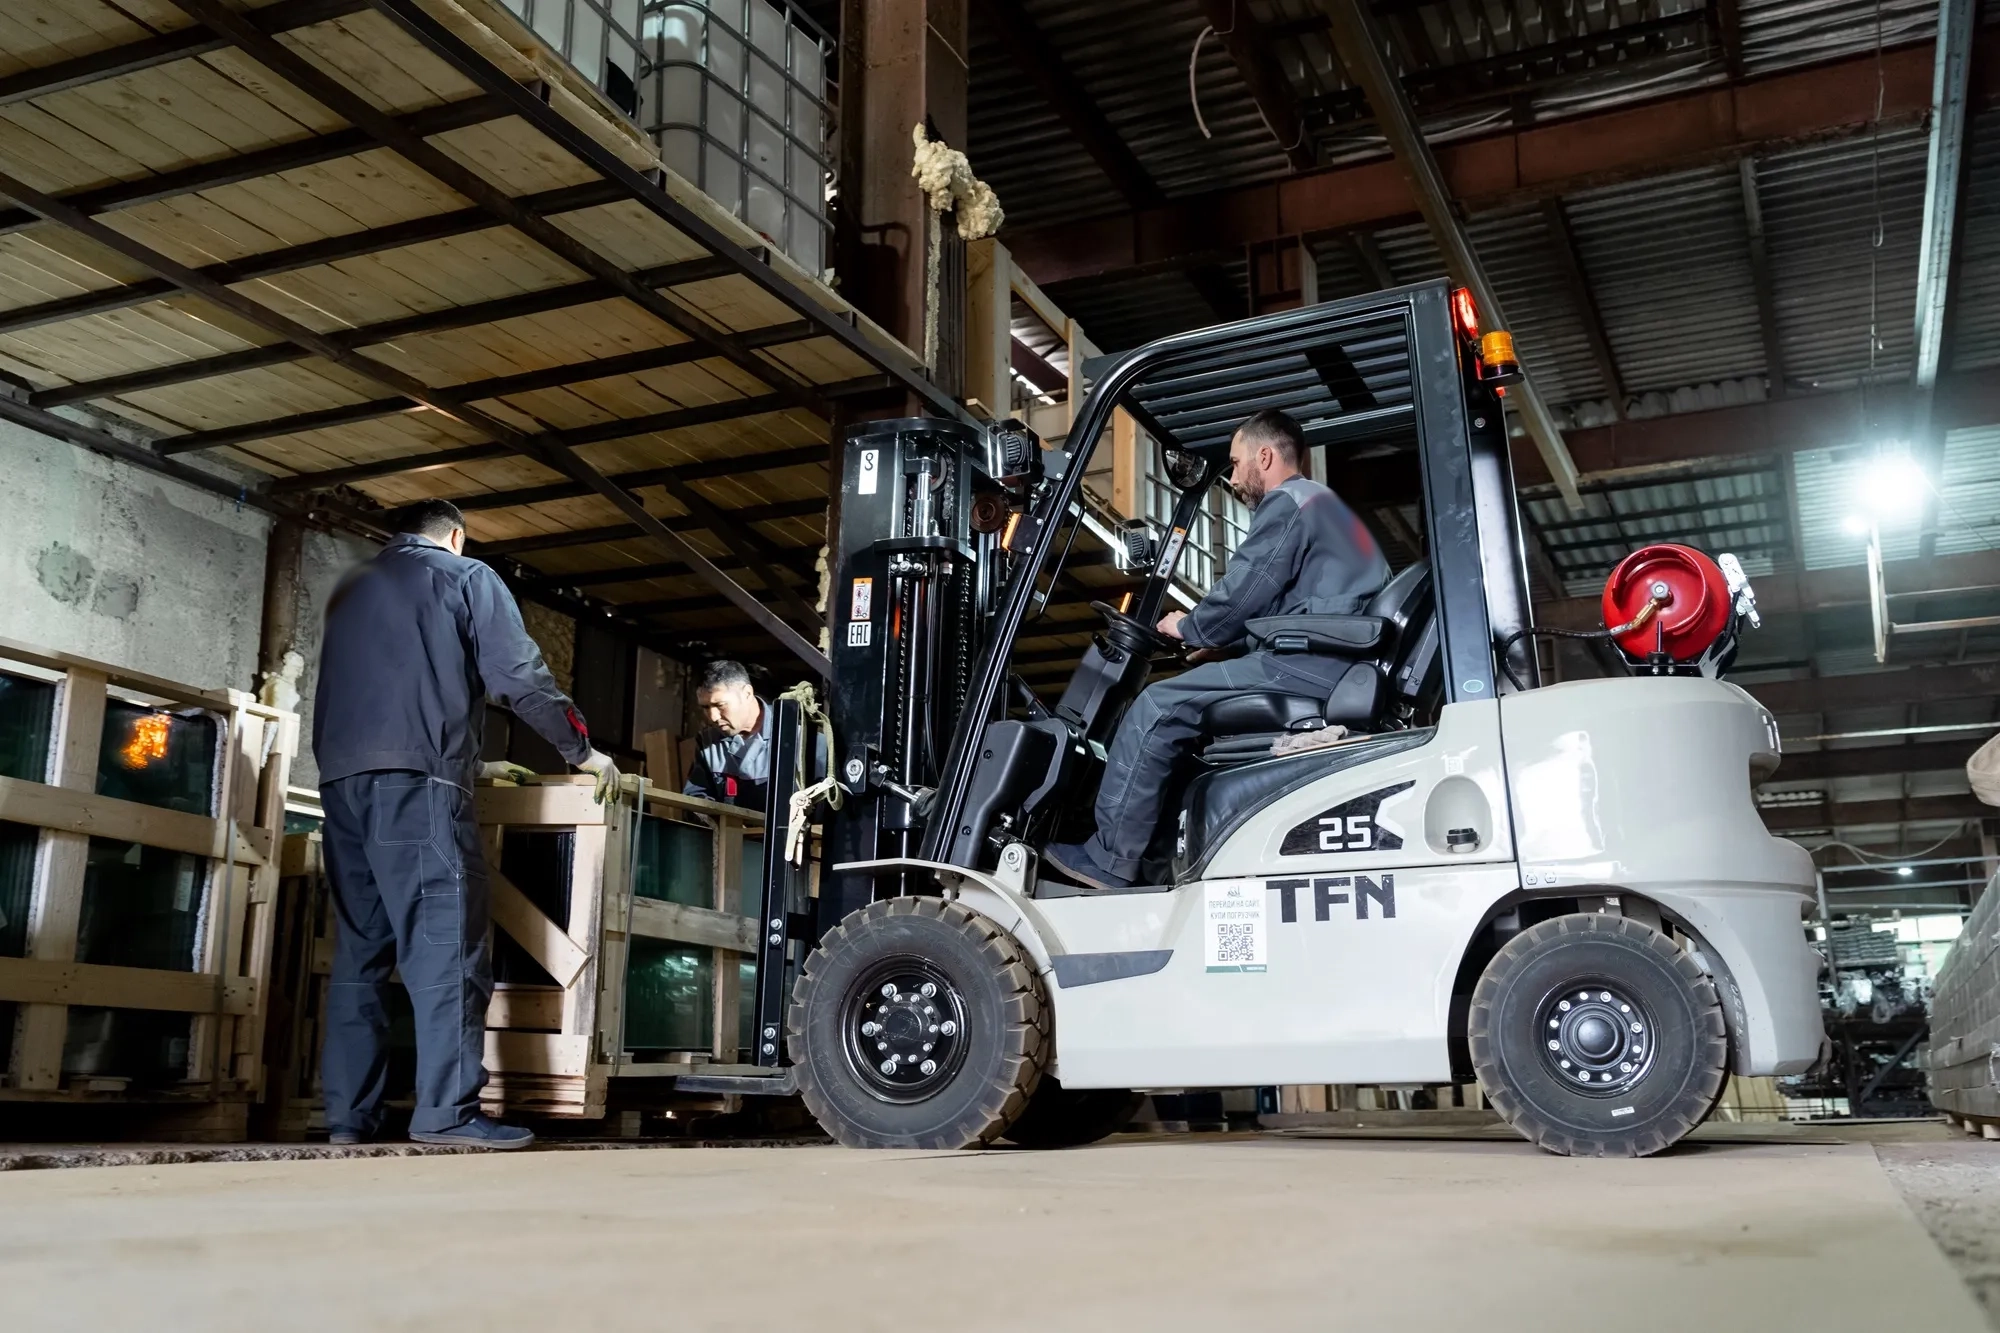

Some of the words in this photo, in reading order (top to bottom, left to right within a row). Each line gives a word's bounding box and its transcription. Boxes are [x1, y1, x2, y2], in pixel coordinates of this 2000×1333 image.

[850, 624, 869, 644] EAC
[1318, 815, 1372, 851] 25
[1265, 873, 1396, 923] TFN
